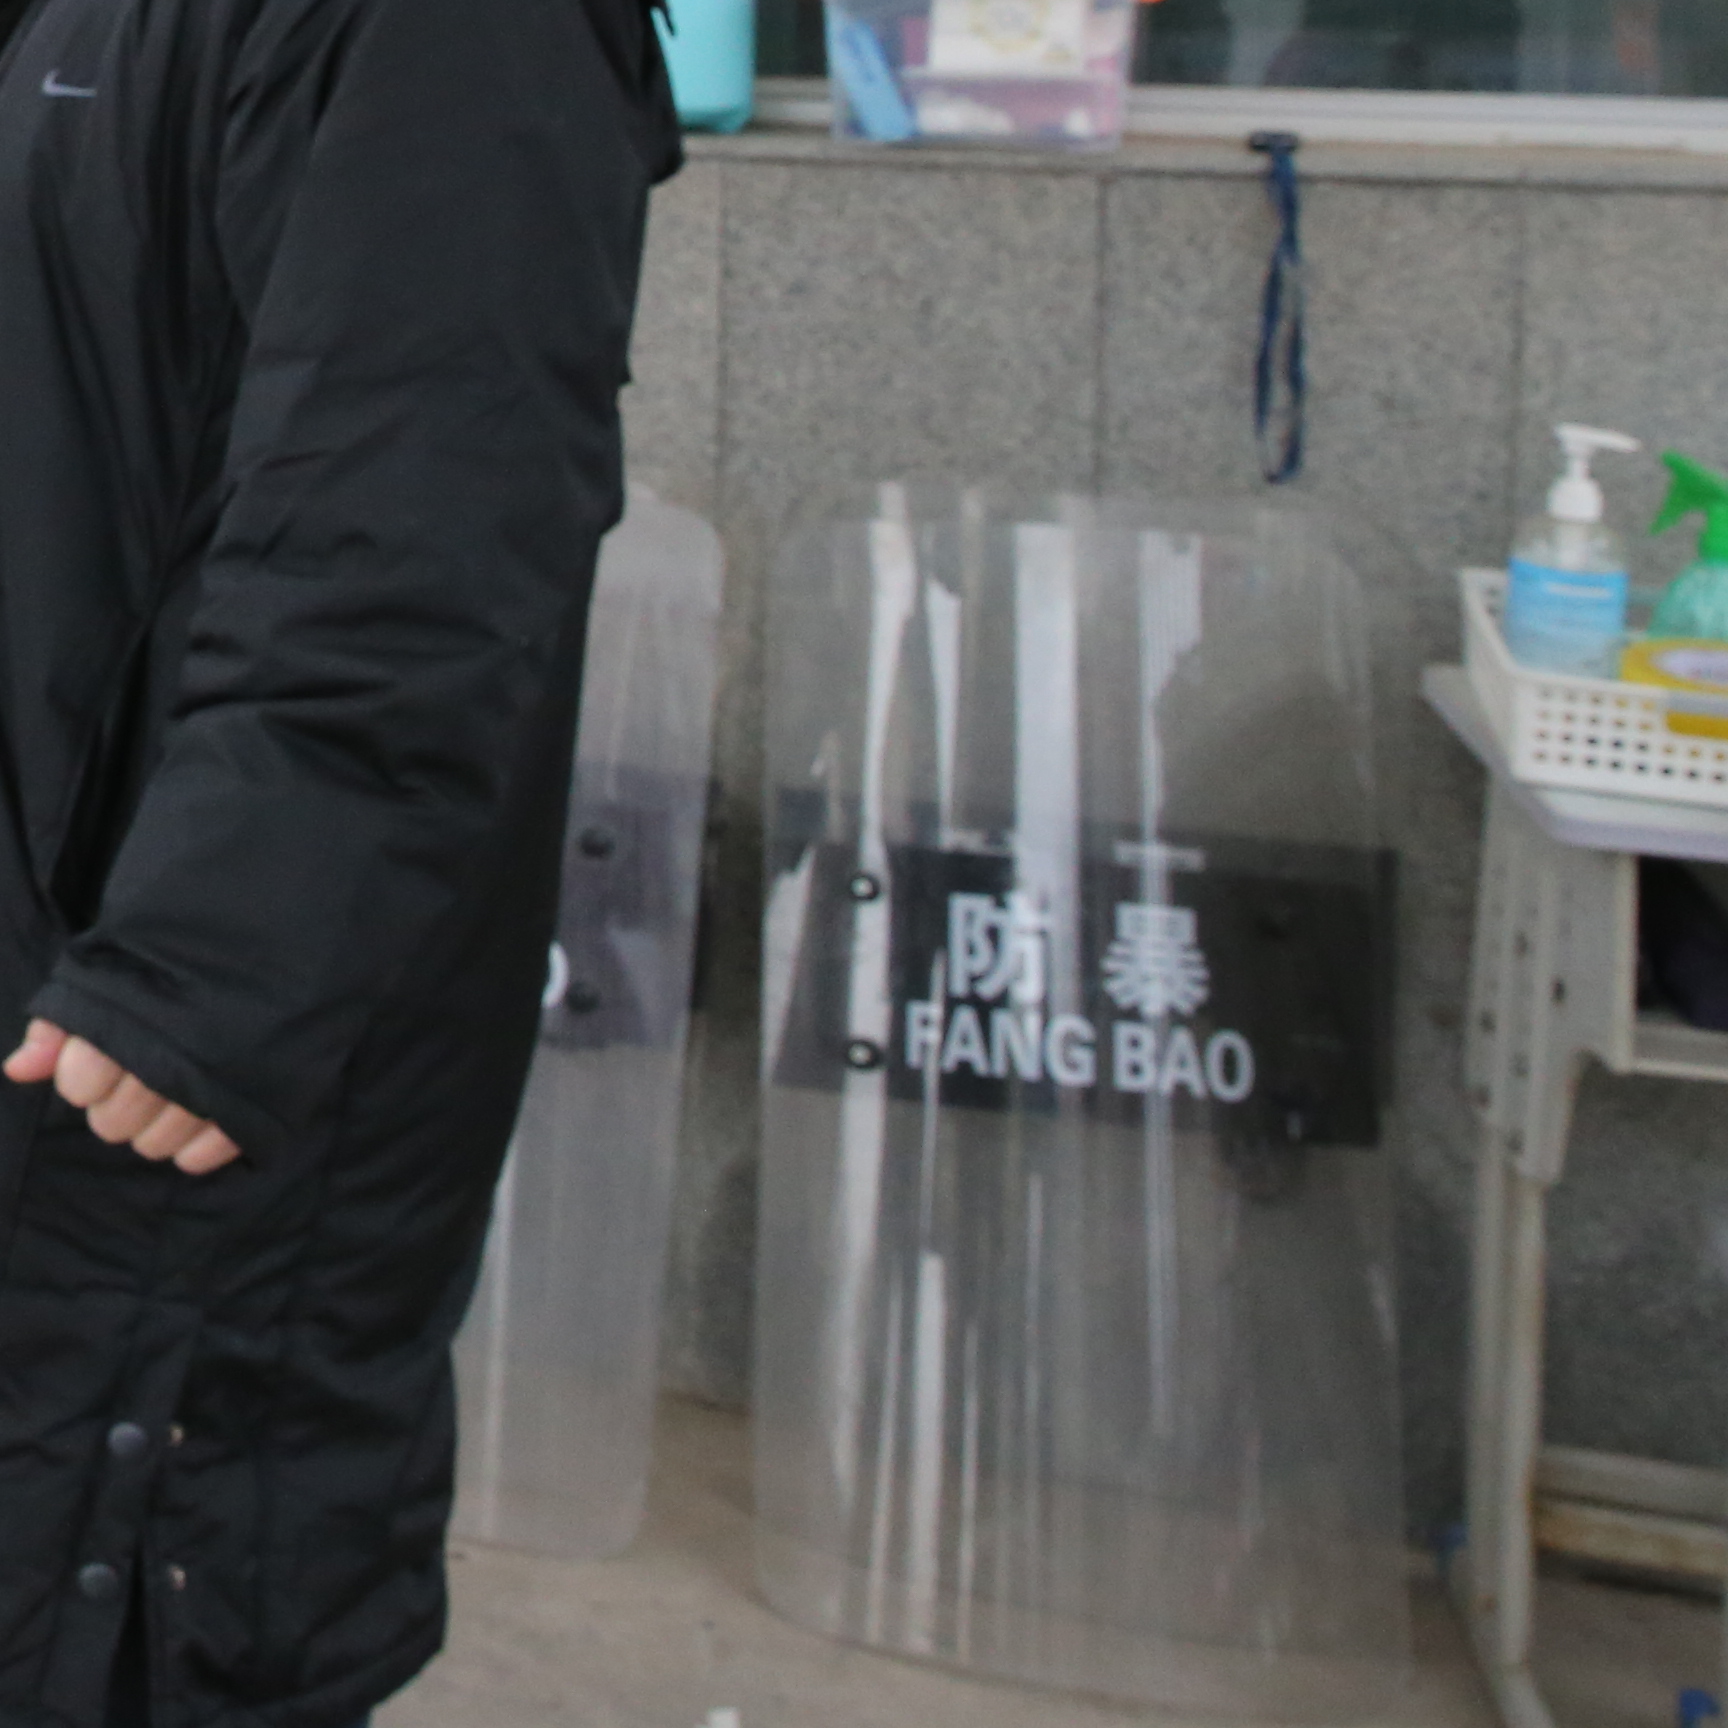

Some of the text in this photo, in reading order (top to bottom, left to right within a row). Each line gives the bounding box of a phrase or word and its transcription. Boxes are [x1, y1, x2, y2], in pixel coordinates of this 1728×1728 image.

[947, 891, 1212, 1018] 防暴
[905, 998, 1256, 1104] FANG BAO
